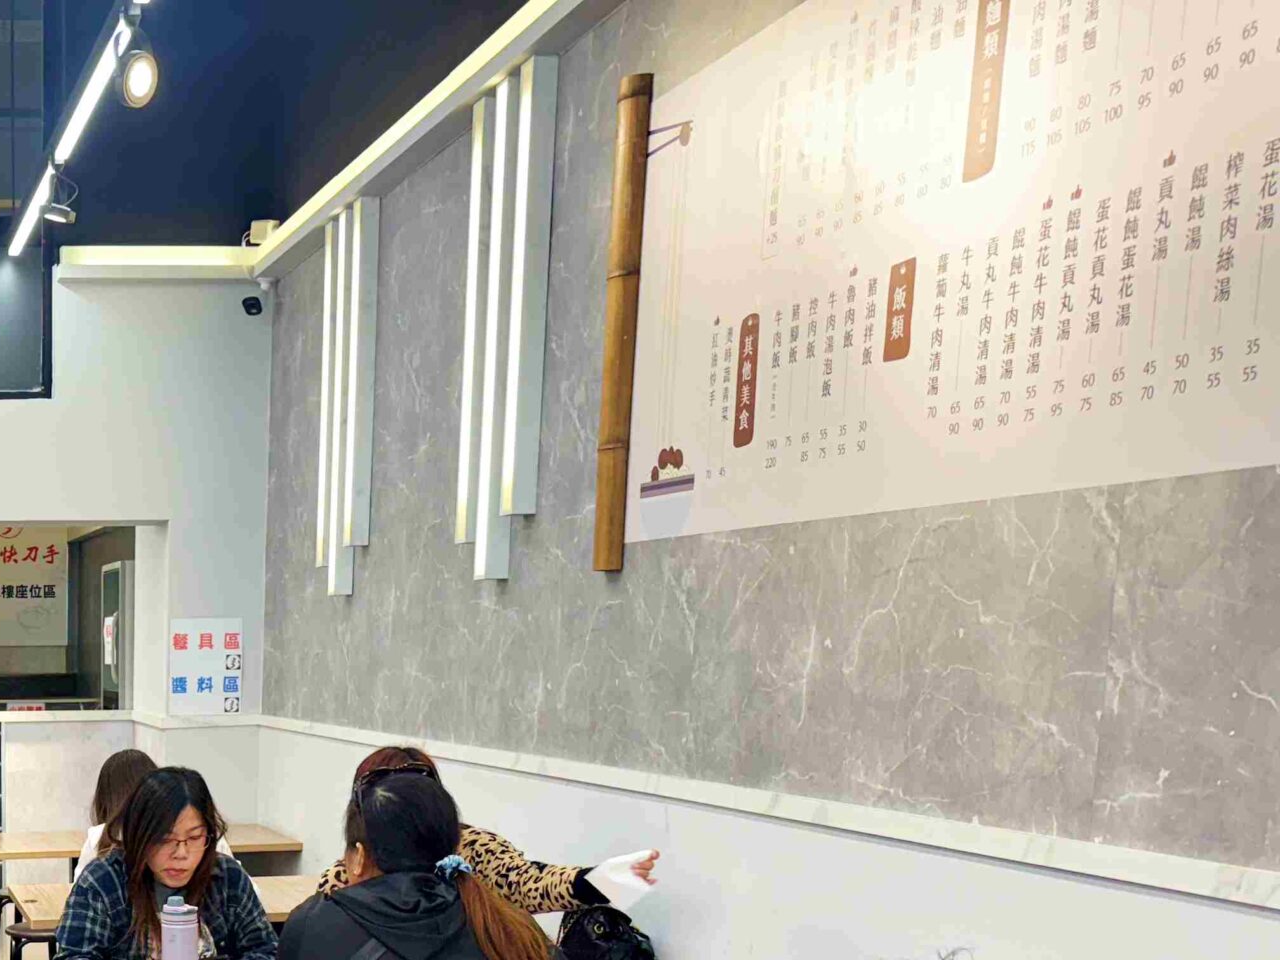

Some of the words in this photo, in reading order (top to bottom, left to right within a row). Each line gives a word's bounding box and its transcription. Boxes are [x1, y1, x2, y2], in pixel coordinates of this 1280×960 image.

[1242, 20, 1258, 40] 65
[1206, 36, 1222, 56] 65
[1171, 52, 1186, 71] 65
[1240, 48, 1256, 69] 90
[1140, 66, 1154, 85] 70
[1204, 63, 1219, 83] 90
[1109, 80, 1121, 97] 75
[1168, 79, 1183, 97] 90
[1077, 93, 1091, 111] 80
[1138, 92, 1152, 111] 95
[1104, 104, 1123, 124] 100
[1074, 117, 1092, 136] 105
[1046, 128, 1063, 147] 105
[1255, 137, 1280, 231] 蛋花湯
[1184, 163, 1209, 252] 餛飩湯
[1152, 175, 1175, 262] 貢丸湯
[1213, 151, 1245, 303] 榨菜肉絲湯
[1115, 186, 1143, 327] 餛飩蛋花湯
[1056, 207, 1081, 342] 餛飩貢丸湯
[1085, 197, 1112, 335] 蛋花貢丸湯
[956, 245, 974, 318] 牛丸湯
[999, 227, 1026, 381] 餛飩牛肉清湯
[1026, 217, 1053, 375] 蛋花牛肉清湯
[890, 284, 907, 341] 飯類
[974, 236, 1000, 387] 貢丸牛肉清湯
[1208, 345, 1224, 363] 35
[1245, 338, 1260, 355] 35
[1143, 360, 1157, 375] 45
[1175, 353, 1190, 369] 50
[738, 335, 754, 431] 其他美食
[1081, 372, 1096, 388] 60
[1111, 366, 1126, 382] 65
[1206, 372, 1221, 390] 55
[1242, 365, 1258, 383] 55
[1025, 385, 1037, 400] 55
[1052, 379, 1065, 394] 75
[1140, 385, 1155, 401] 70
[1172, 379, 1187, 395] 70
[973, 396, 985, 410] 65
[999, 391, 1011, 404] 70
[1079, 397, 1093, 412] 75
[1109, 391, 1123, 407] 85
[927, 406, 938, 419] 70
[950, 401, 961, 414] 65
[1023, 408, 1035, 422] 75
[1050, 402, 1063, 417] 95
[858, 420, 868, 433] 30
[948, 422, 960, 435] 90
[972, 418, 984, 431] 90
[997, 413, 1009, 426] 90
[801, 432, 810, 445] 65
[819, 428, 828, 441] 55
[839, 424, 848, 437] 35
[818, 447, 827, 460] 75
[837, 443, 846, 456] 55
[856, 440, 867, 453] 50
[800, 451, 809, 463] 85
[173, 632, 240, 651] 餐具區
[171, 676, 240, 694] 醬料區
